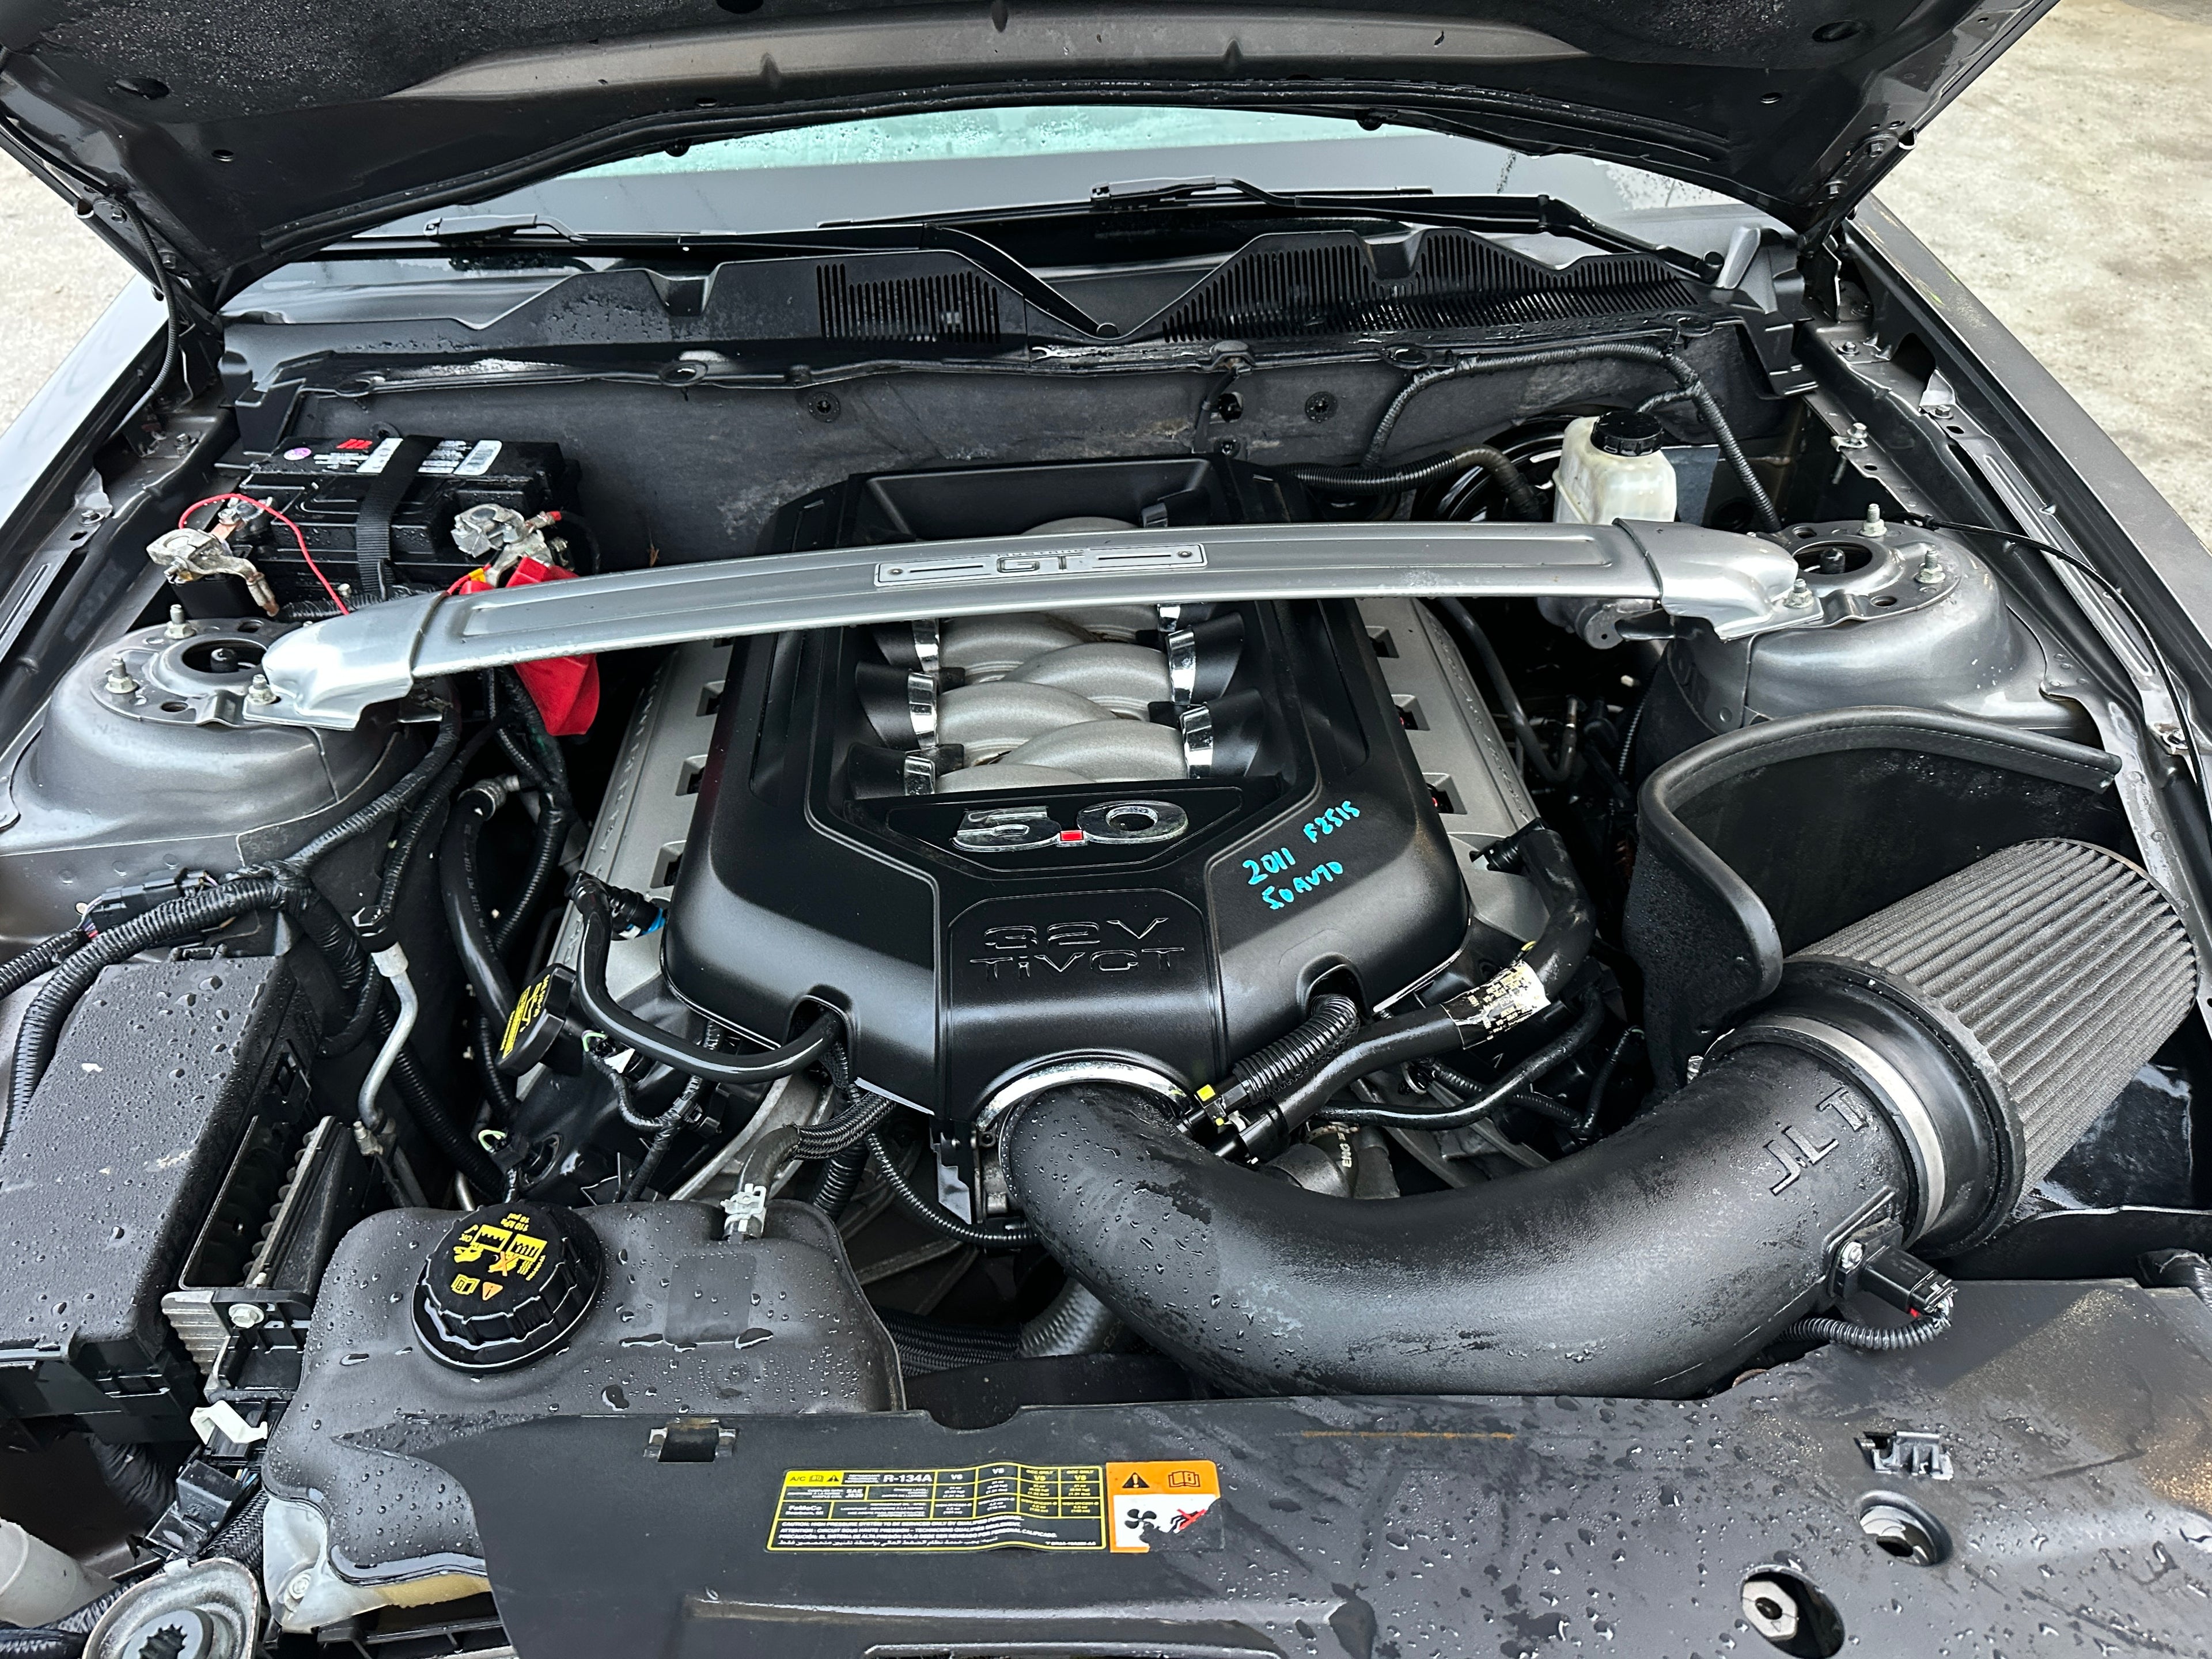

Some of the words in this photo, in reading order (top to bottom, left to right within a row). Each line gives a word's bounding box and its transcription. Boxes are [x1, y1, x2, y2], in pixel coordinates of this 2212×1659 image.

[997, 552, 1085, 573] GT
[949, 800, 1189, 852] 5.0
[1242, 847, 1296, 885] 2011
[984, 917, 1169, 949] 32V
[1763, 1086, 1869, 1197] JLT
[459, 1233, 473, 1243] OK
[883, 1474, 933, 1483] R-134A
